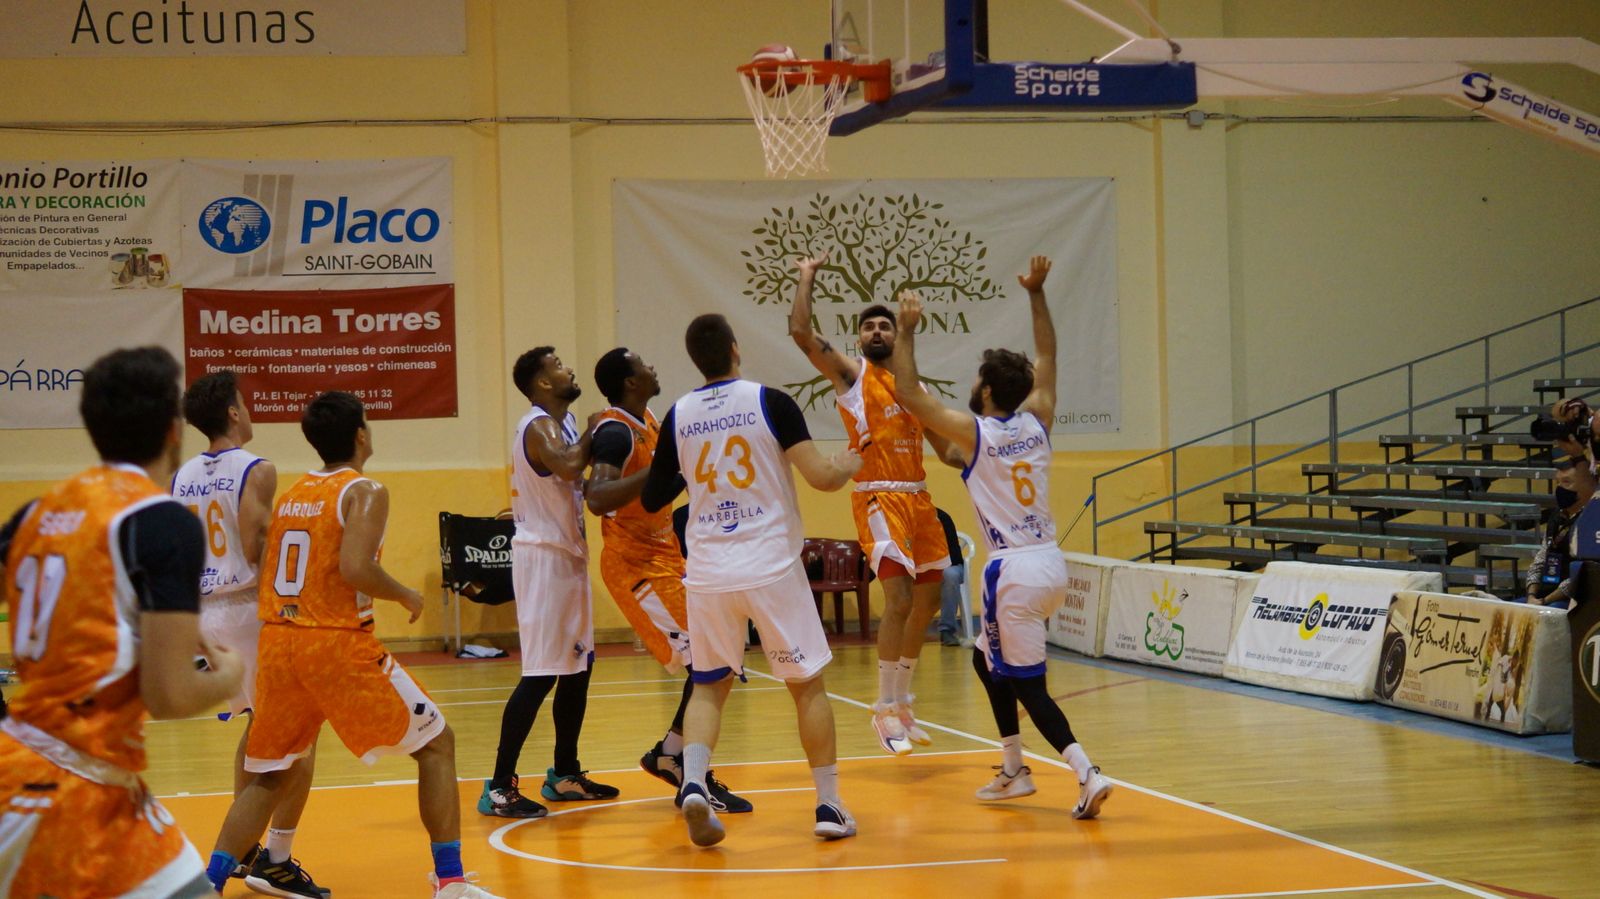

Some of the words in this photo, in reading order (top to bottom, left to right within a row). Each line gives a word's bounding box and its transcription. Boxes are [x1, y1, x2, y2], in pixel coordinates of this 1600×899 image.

[71, 0, 315, 44] Aceitunas
[1015, 64, 1099, 82] Schelde
[1015, 80, 1100, 99] Sports
[1499, 87, 1570, 124] Schelde
[53, 165, 148, 188] Portillo
[20, 196, 31, 209] Y
[36, 193, 145, 209] DECORACIÓN
[18, 214, 31, 222] de
[34, 214, 70, 223] Pintura
[87, 213, 127, 222] General
[300, 196, 441, 244] Placo
[40, 225, 99, 234] Decorativas
[38, 238, 51, 246] de
[54, 237, 102, 246] Cubiertas
[105, 238, 111, 248] y
[114, 236, 153, 245] Azoteas
[54, 249, 67, 258] de
[69, 249, 109, 258] Vecinos
[304, 253, 433, 271] SAINT-GOBAIN
[200, 308, 322, 335] Medina
[333, 308, 441, 334] Torres
[190, 347, 225, 358] baños
[234, 346, 293, 358] cerámicas
[301, 345, 359, 357] materiales
[362, 345, 377, 355] de
[379, 342, 452, 355] construcción
[268, 362, 326, 373] fontanería
[335, 363, 368, 375] yesos
[377, 360, 437, 371] chimeneas
[253, 391, 268, 400] P.I.
[270, 391, 281, 400] El
[283, 391, 307, 402] Tejar
[368, 389, 379, 398] 11
[380, 388, 393, 398] 32
[254, 402, 285, 412] Morón
[286, 403, 300, 412] de
[987, 434, 1044, 458] CAMERON
[694, 434, 757, 494] 43
[180, 478, 235, 497] SÁNCHEZ
[1010, 460, 1036, 507] 6
[698, 506, 765, 525] MARBELLA
[185, 499, 227, 558] 6
[273, 529, 311, 598] 0
